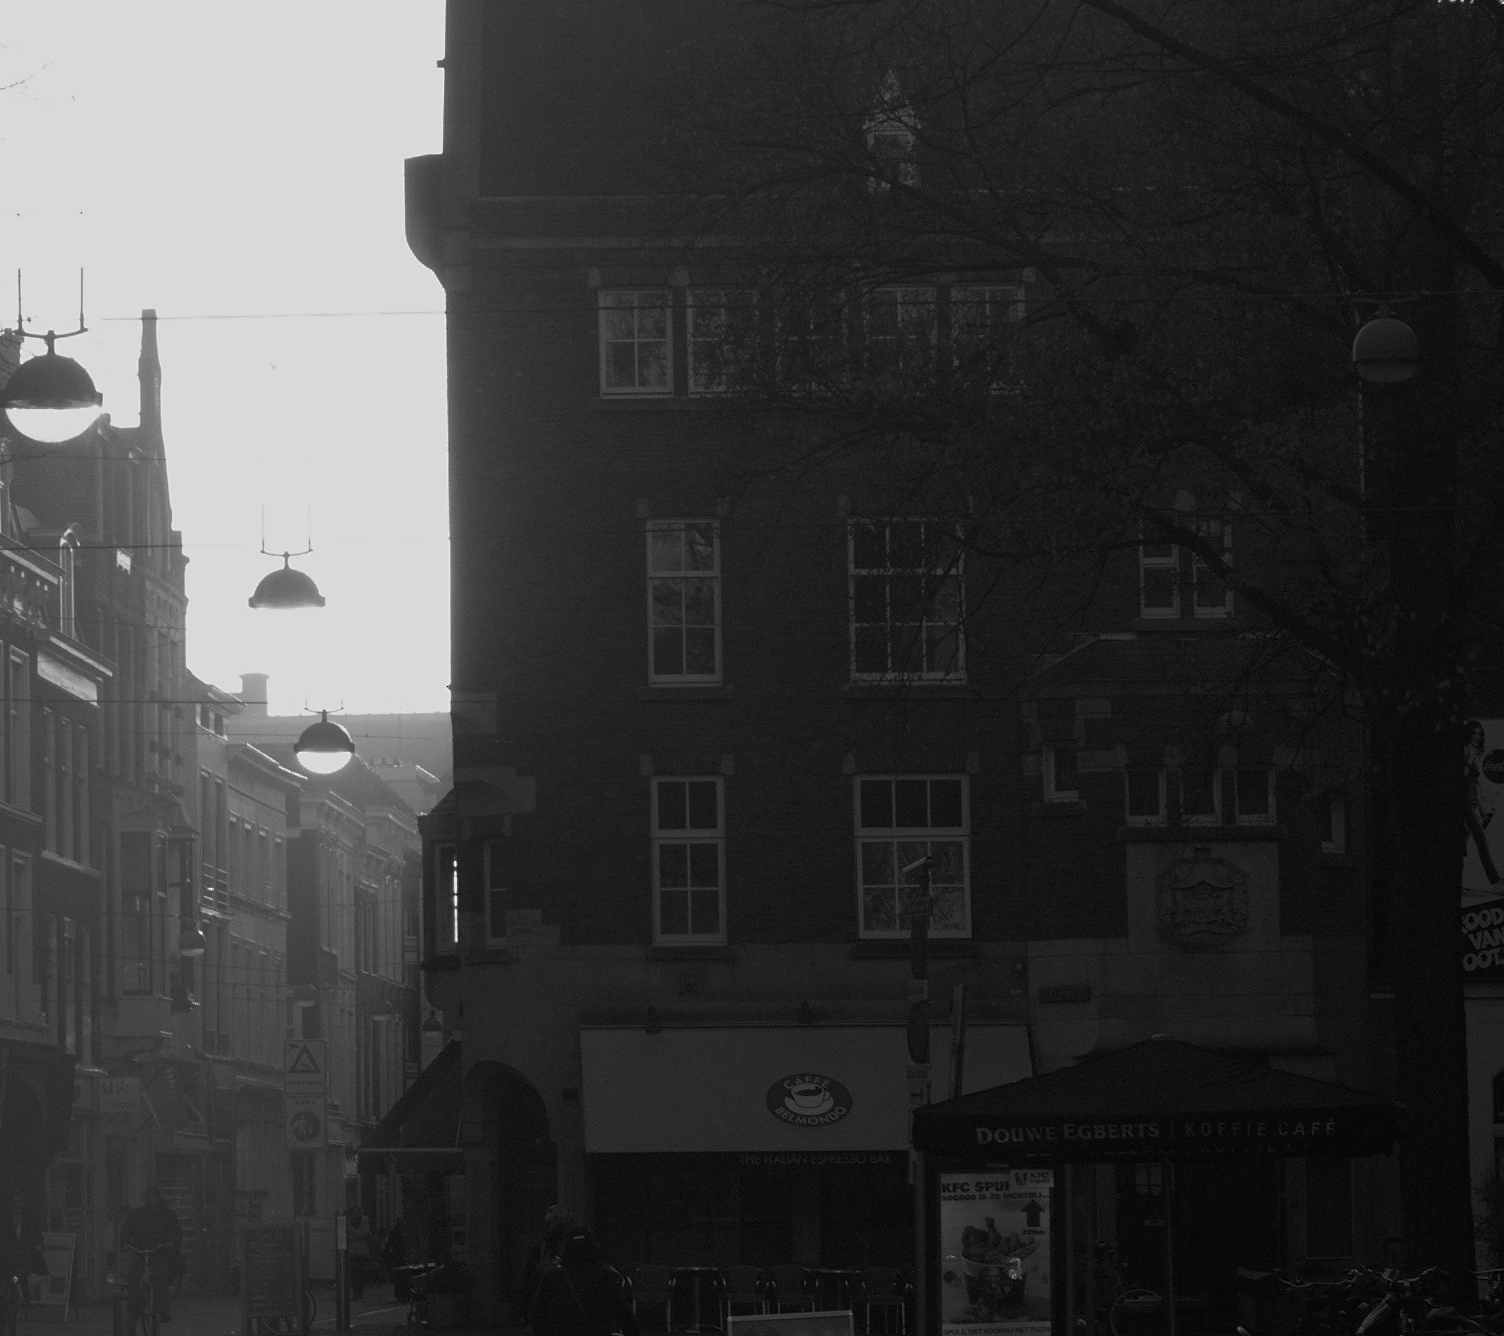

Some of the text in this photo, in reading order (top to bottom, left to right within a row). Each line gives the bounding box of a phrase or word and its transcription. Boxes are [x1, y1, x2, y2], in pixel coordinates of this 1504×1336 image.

[775, 1105, 846, 1126] BELMONDO
[976, 1116, 1336, 1145] DOUWE EGBERTS KOFFIE CAFÉ
[740, 1153, 893, 1165] THE ITALIAN ESPRESSO BAR
[941, 1180, 1010, 1193] KFC SPUI
